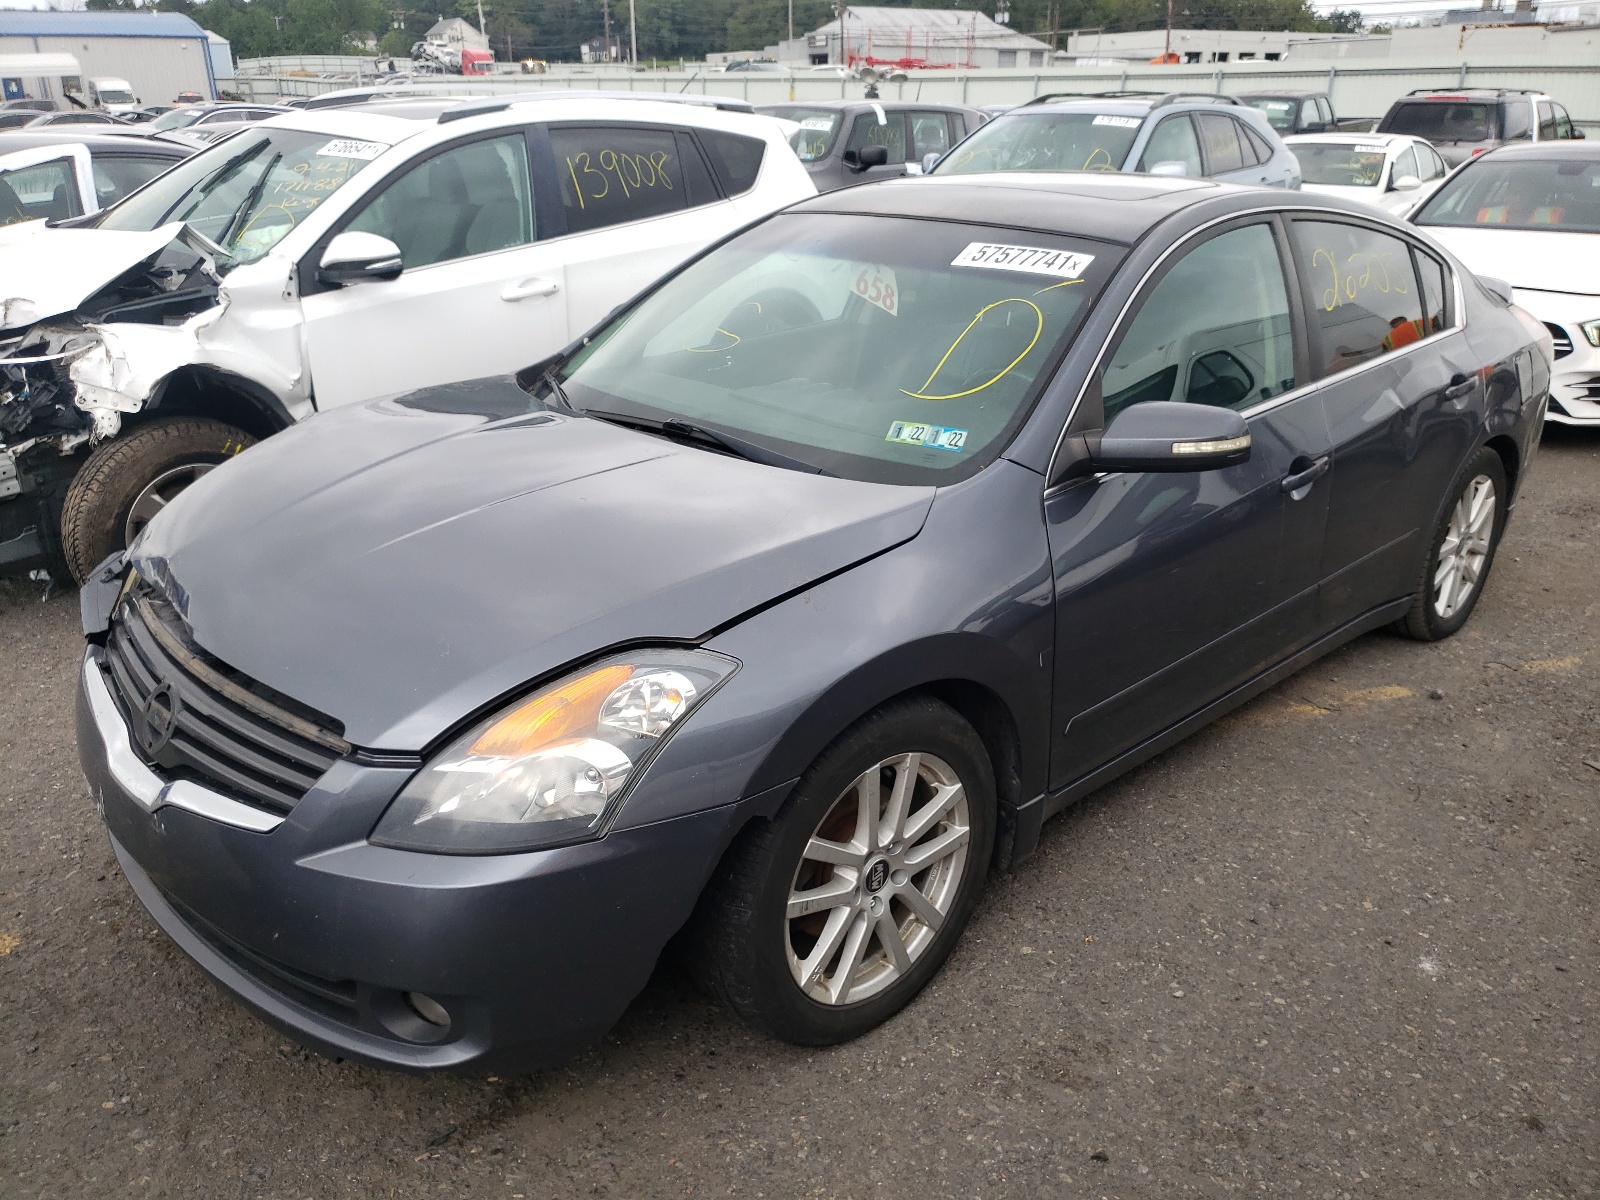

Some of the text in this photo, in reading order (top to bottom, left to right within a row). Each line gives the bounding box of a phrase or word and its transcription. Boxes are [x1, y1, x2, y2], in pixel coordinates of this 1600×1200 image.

[273, 177, 343, 195] 171188
[565, 149, 674, 210] 139008
[856, 269, 895, 311] 658
[912, 427, 925, 440] 22
[949, 432, 962, 447] 22
